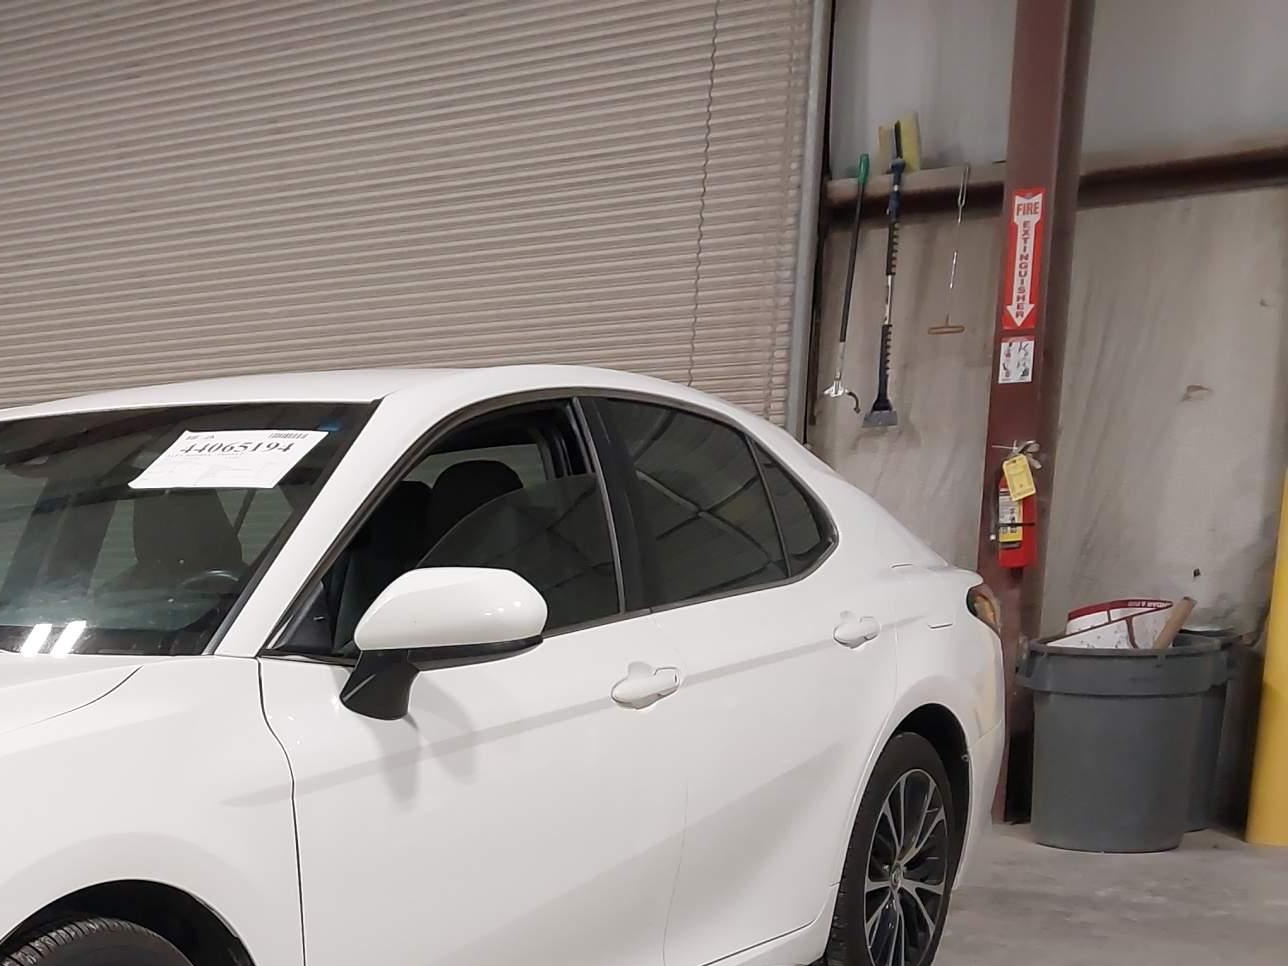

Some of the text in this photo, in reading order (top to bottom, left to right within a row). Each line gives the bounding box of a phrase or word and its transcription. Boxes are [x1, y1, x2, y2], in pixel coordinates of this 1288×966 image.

[1016, 201, 1040, 217] FIRE
[1015, 220, 1031, 318] EXTINGUISHER
[180, 441, 295, 454] 44065194
